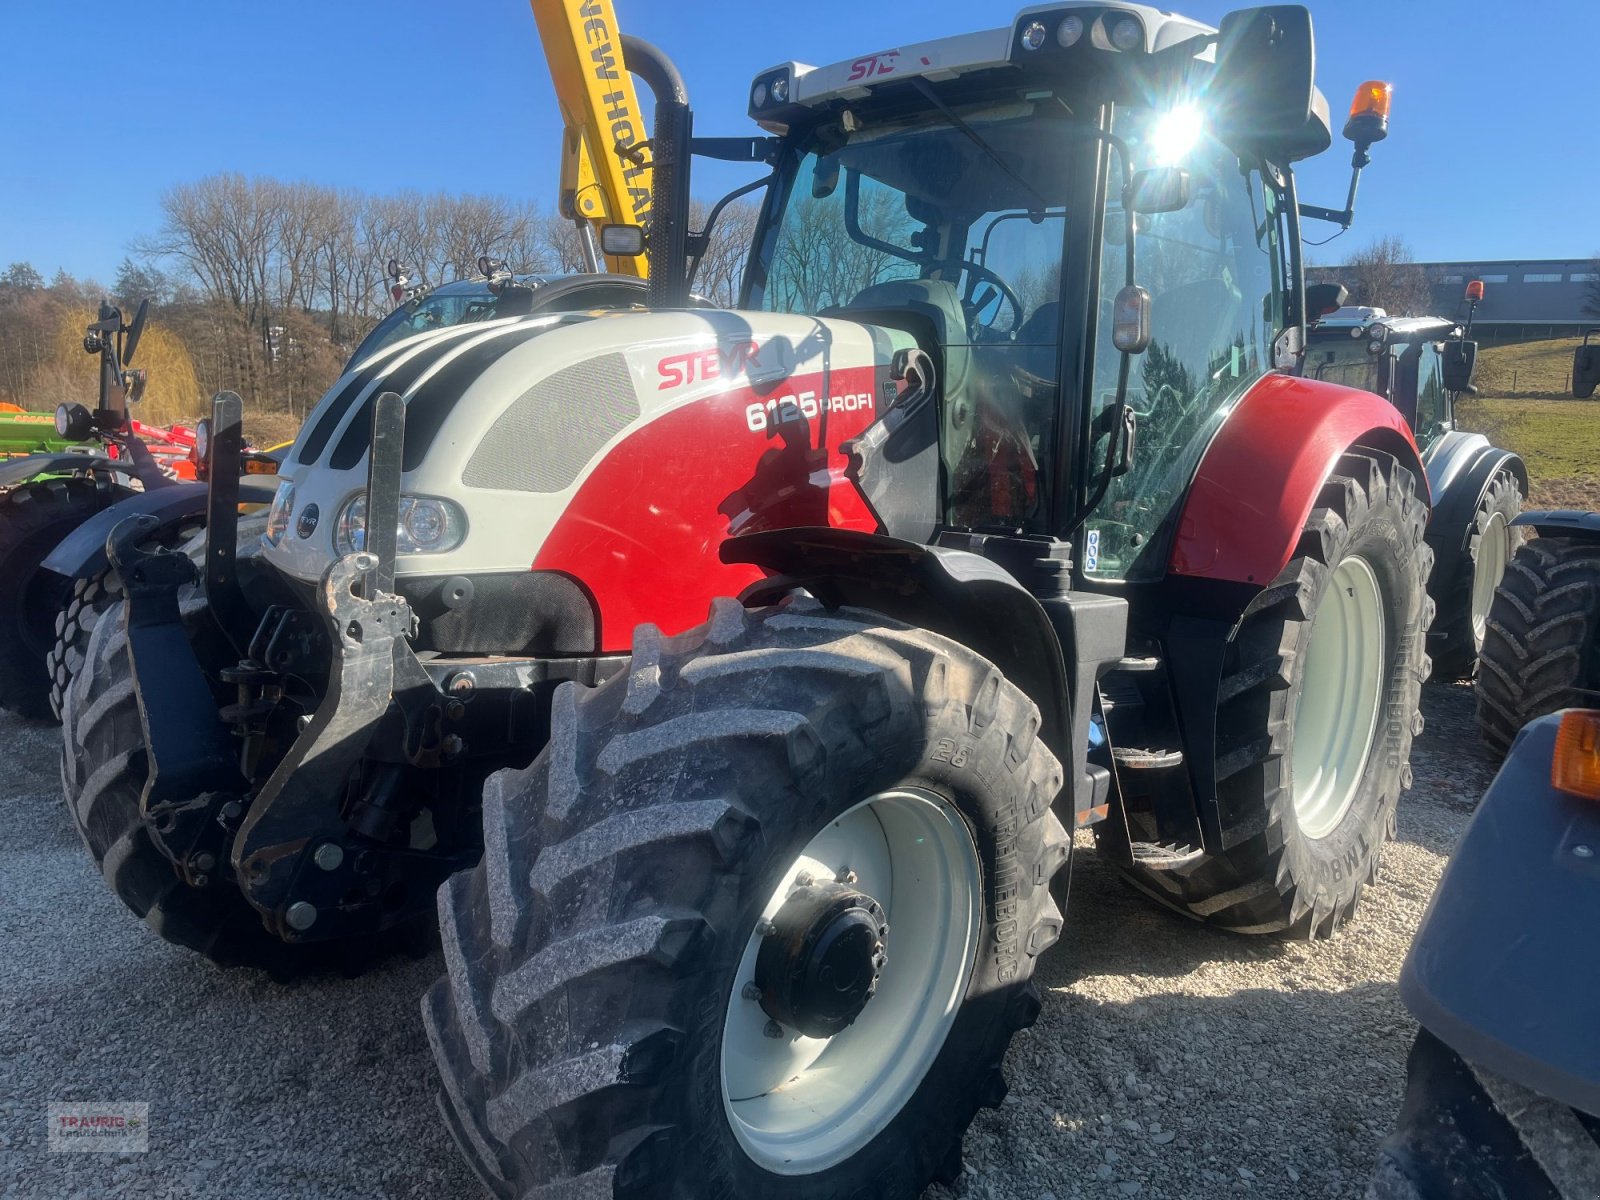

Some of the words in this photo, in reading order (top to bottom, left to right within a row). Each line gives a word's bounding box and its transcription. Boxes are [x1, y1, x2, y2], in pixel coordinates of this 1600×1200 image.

[579, 0, 620, 80] NEW
[657, 341, 762, 391] STEYR
[745, 390, 818, 432] 6125
[819, 393, 873, 415] PROFI
[930, 737, 974, 768] 28
[994, 795, 1019, 984] TRELLEBORG
